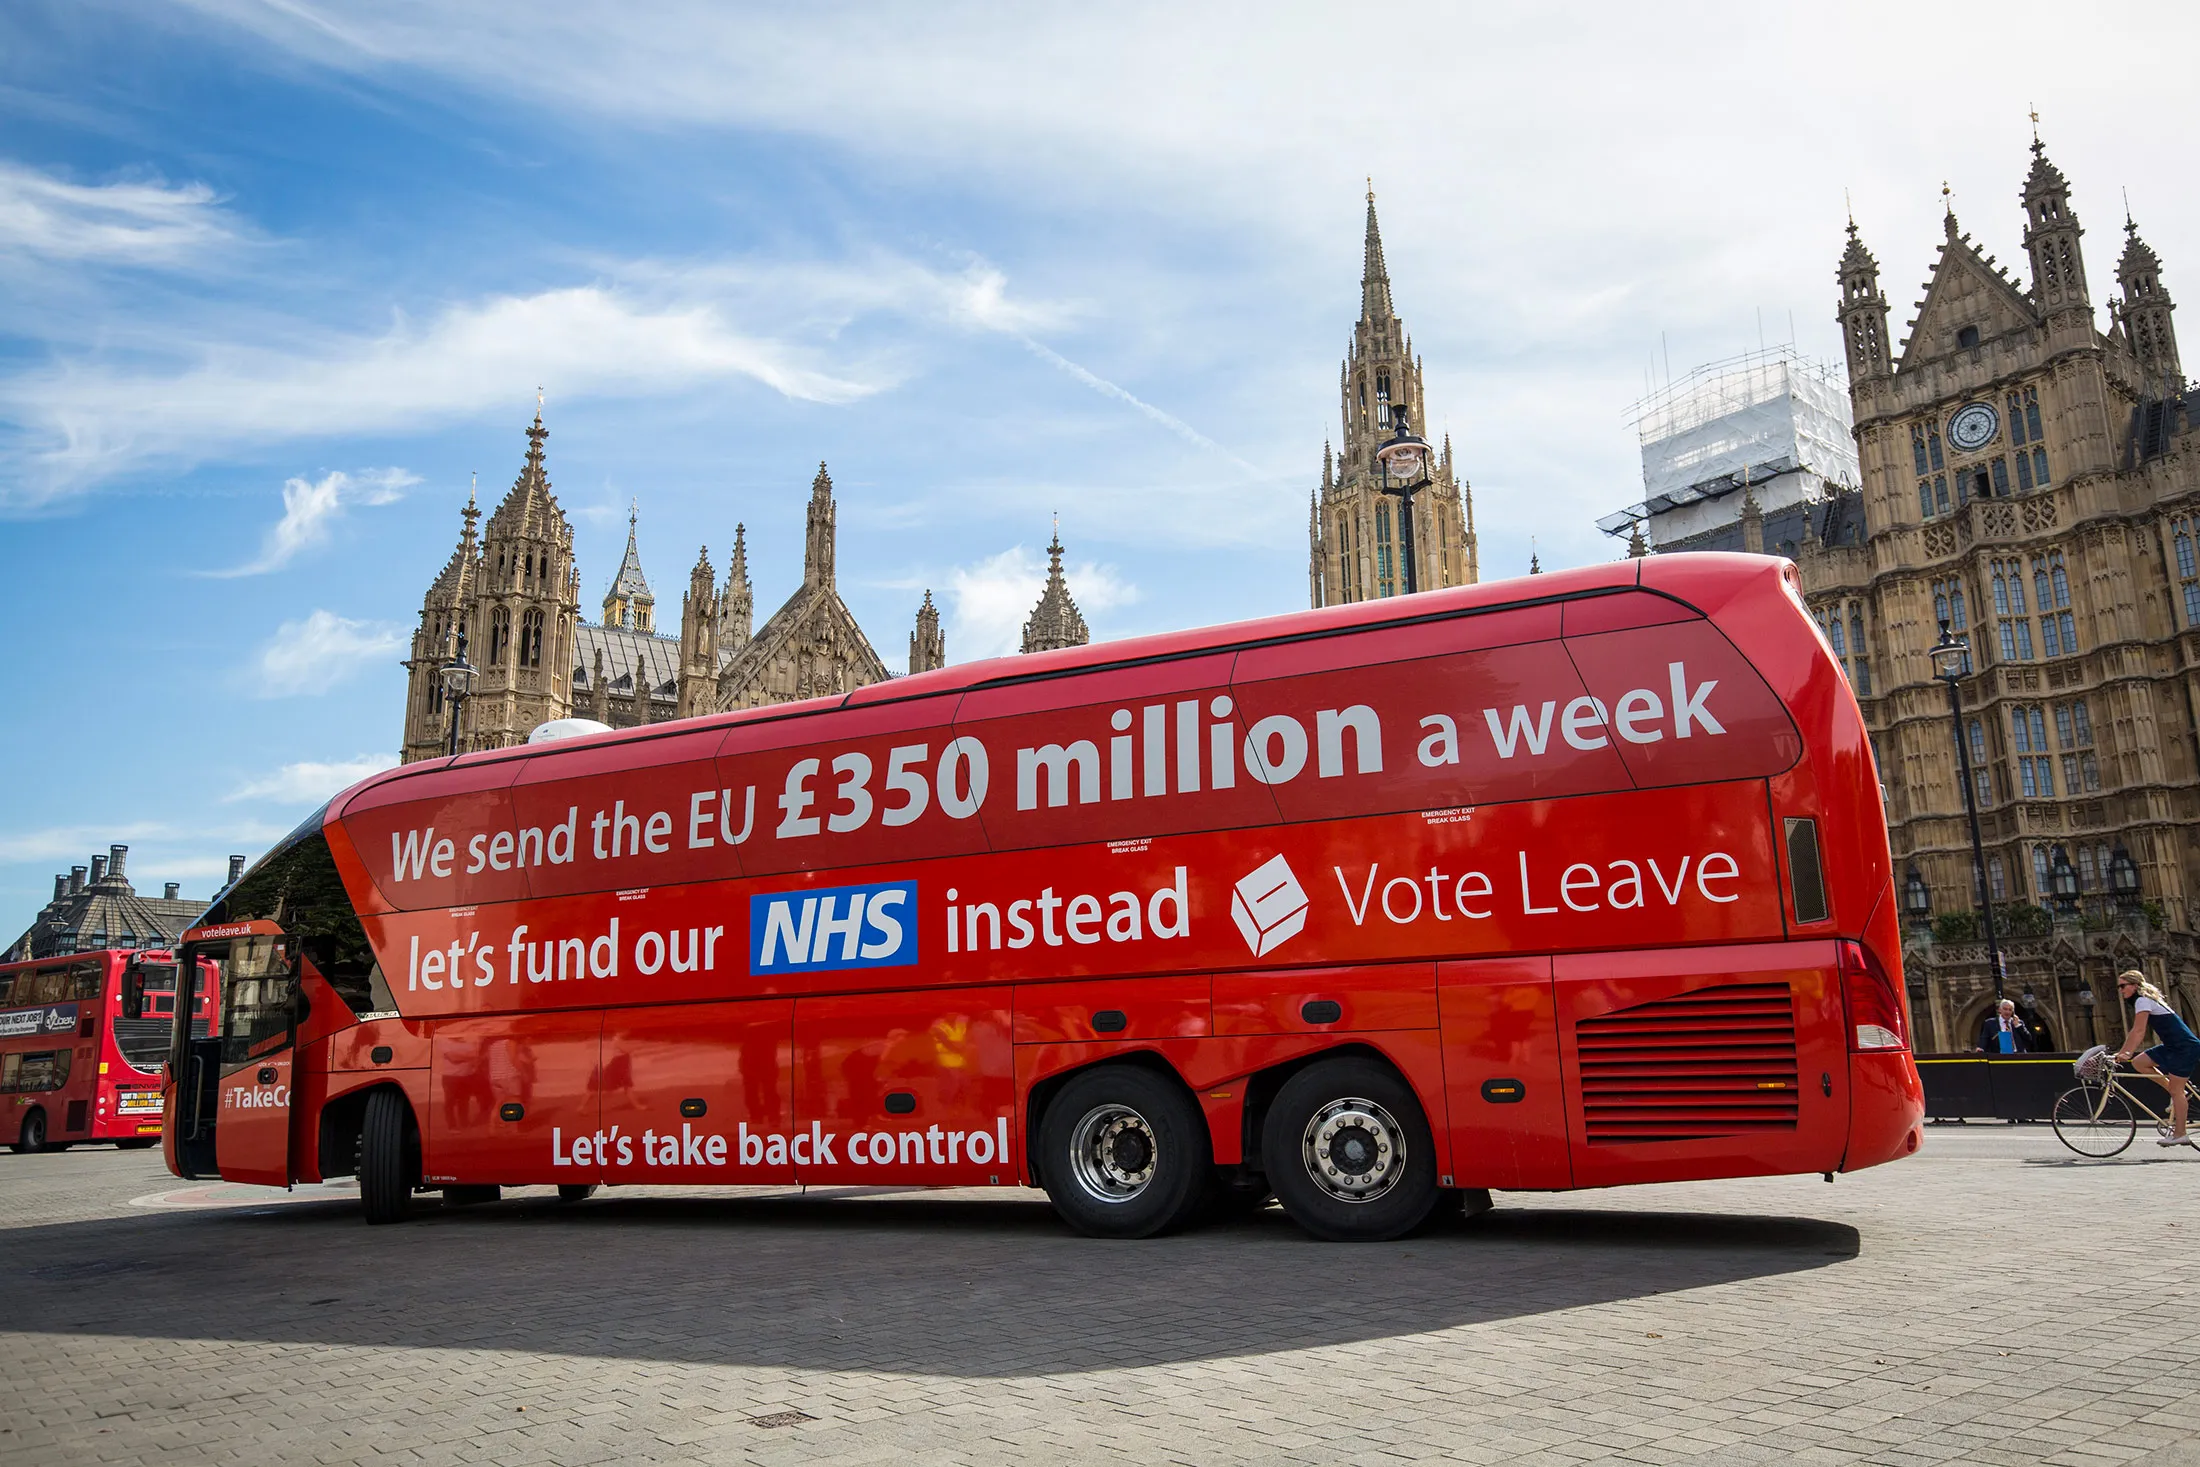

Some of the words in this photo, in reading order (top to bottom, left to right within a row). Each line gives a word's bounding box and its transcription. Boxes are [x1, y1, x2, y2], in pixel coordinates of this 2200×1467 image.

[393, 827, 455, 882] We
[467, 806, 578, 874] send
[591, 800, 672, 859] the
[688, 785, 756, 849] EU
[776, 736, 990, 839] £350
[1016, 694, 1384, 811] million
[1417, 714, 1460, 768] a
[1483, 661, 1727, 759] week
[1422, 809, 1460, 818] EMERGENCY
[1334, 862, 1493, 926] Vote
[1519, 850, 1739, 915] Leave
[201, 924, 252, 938] voteleave.uk
[408, 930, 495, 992] let's
[508, 917, 619, 984] fund
[635, 925, 724, 975] our
[759, 889, 908, 967] NHS
[946, 865, 1190, 953] instead
[553, 1126, 633, 1166] Let's
[642, 1122, 728, 1166] take
[738, 1120, 839, 1166] back
[847, 1117, 1010, 1165] control
